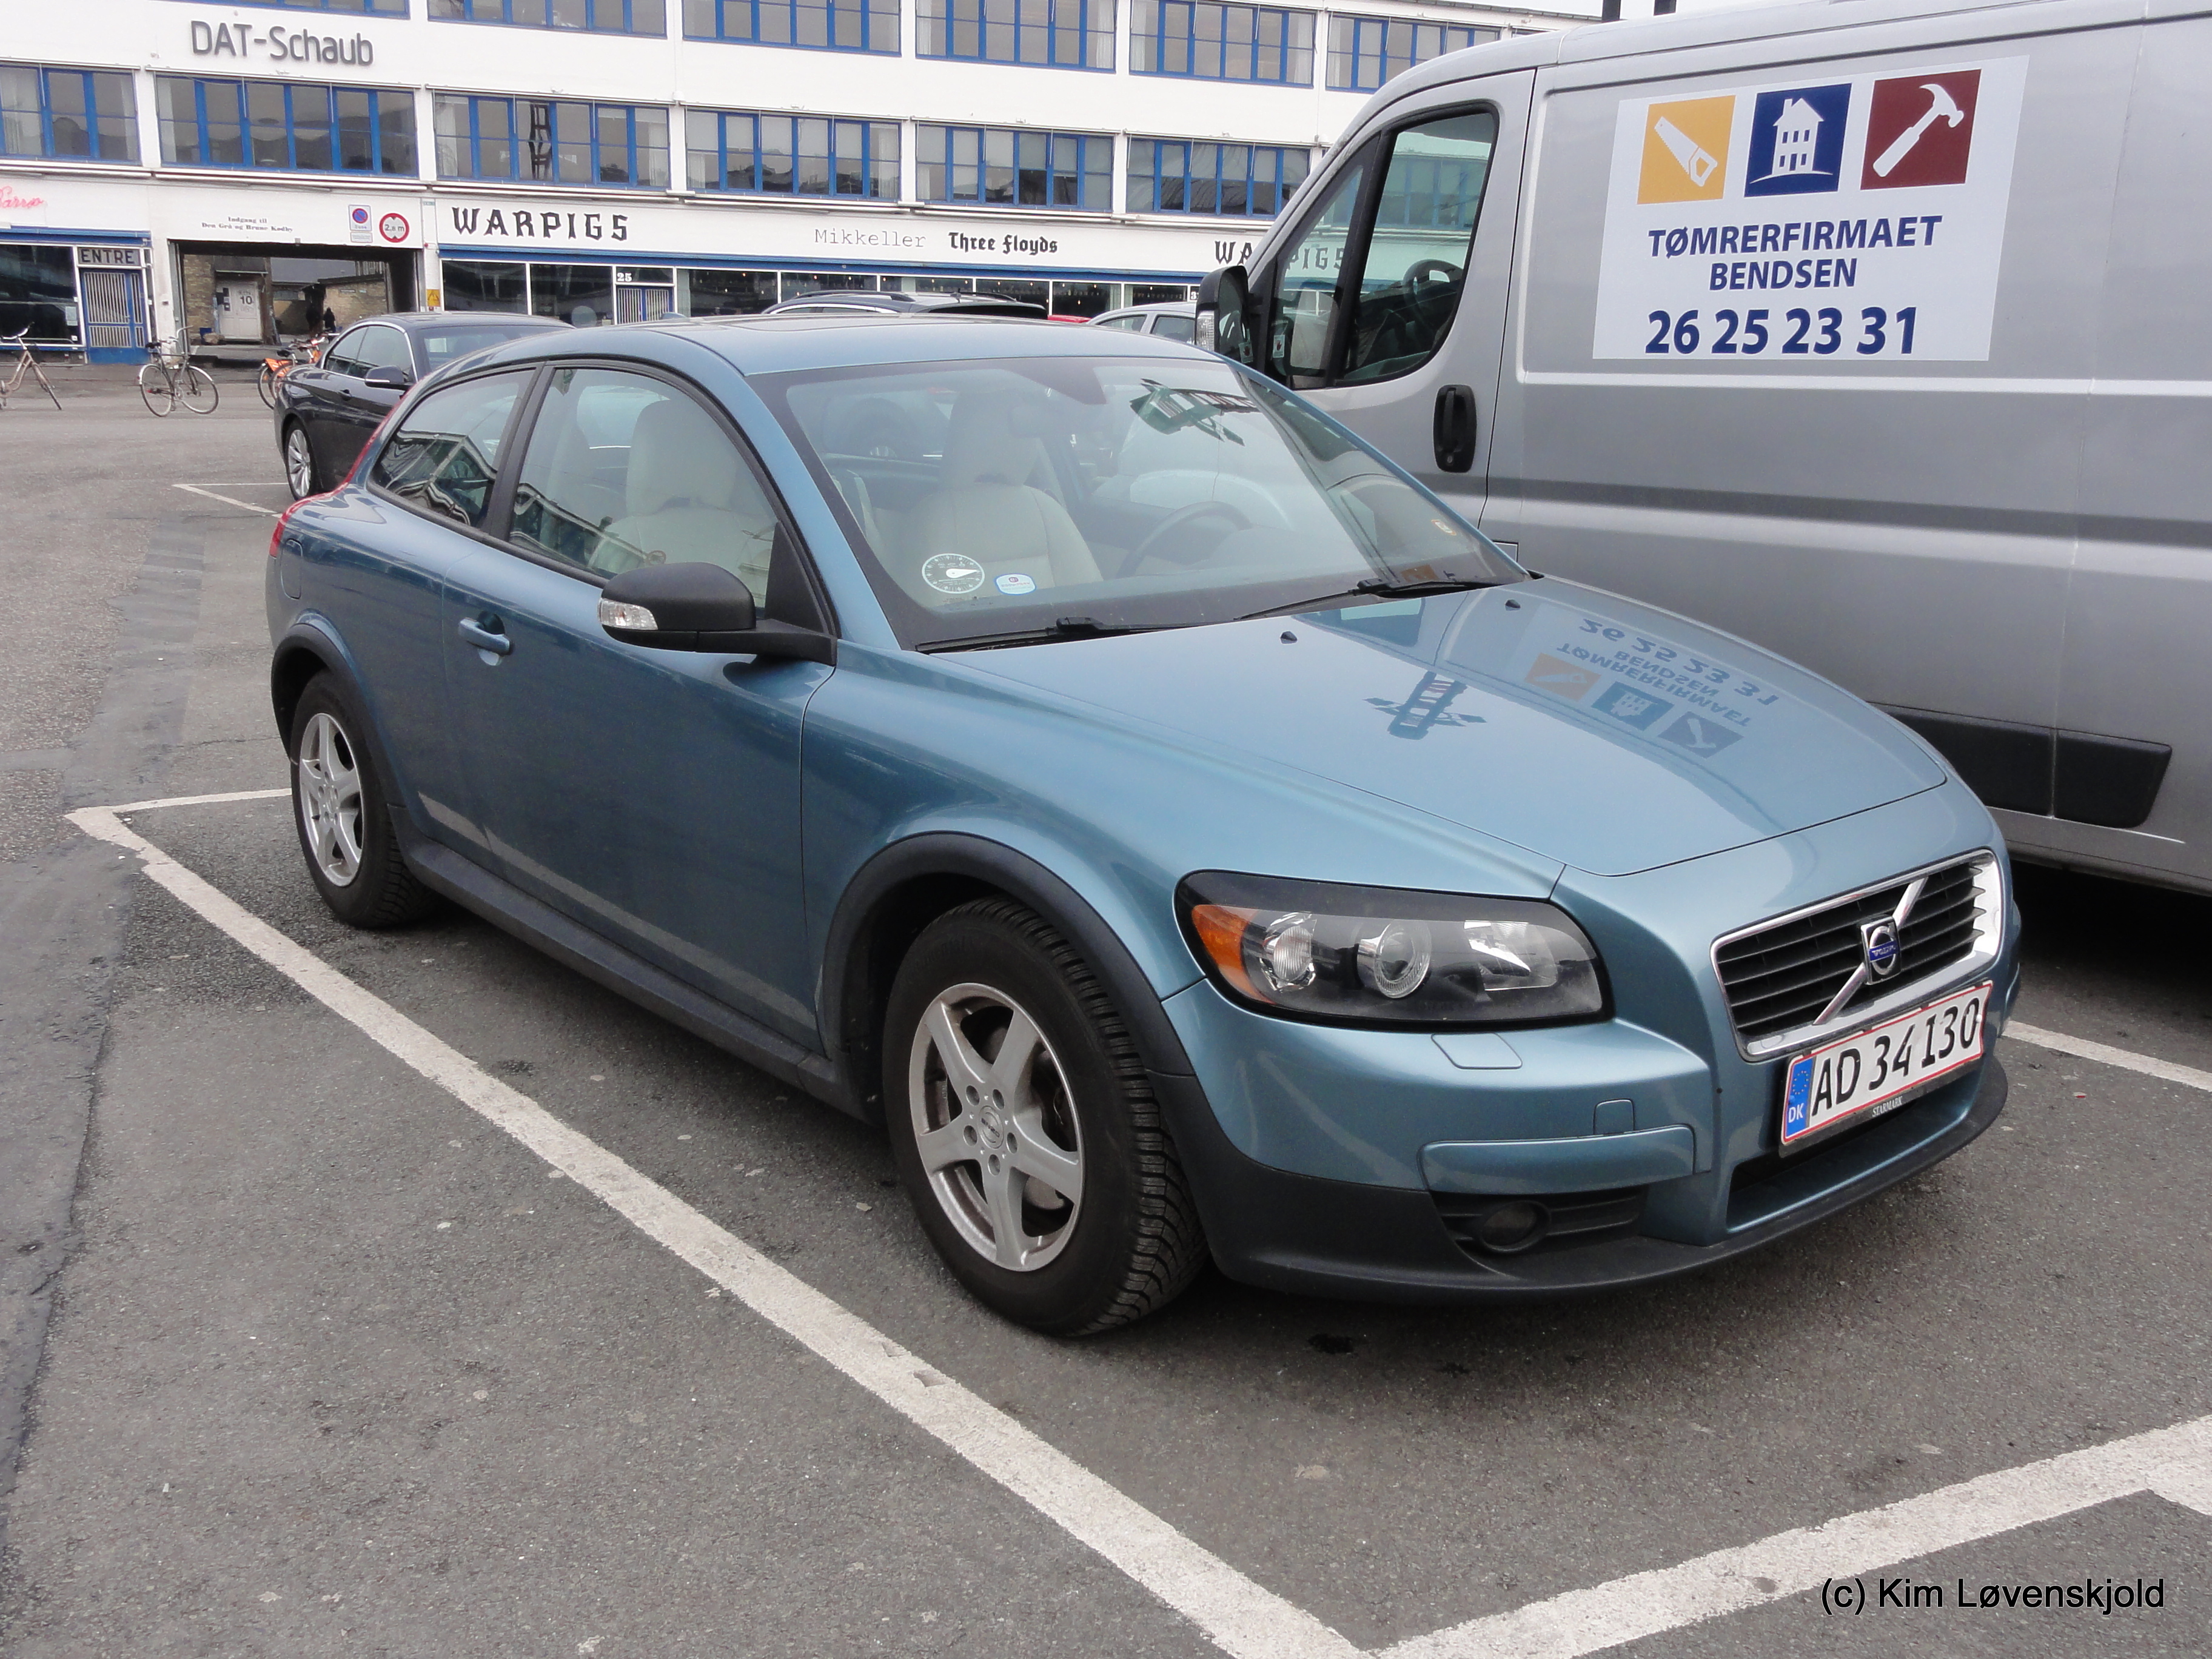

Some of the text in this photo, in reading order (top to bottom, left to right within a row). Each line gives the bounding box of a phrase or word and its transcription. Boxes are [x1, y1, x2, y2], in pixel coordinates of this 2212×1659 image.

[190, 20, 374, 65] DAT-Schaub
[452, 207, 628, 241] WARPIGS
[814, 228, 926, 247] Mikkeller
[948, 232, 996, 253] Three
[1648, 215, 1943, 259] TØMRERFIRMAET
[81, 249, 135, 264] ENTRE
[1215, 241, 1346, 270] WAPIGS
[617, 272, 632, 282] 25
[1709, 258, 1858, 290] BENDSEN
[240, 295, 252, 305] 10
[1644, 306, 1917, 355] 26 25 23 31
[1811, 997, 1979, 1116] AD 34 130
[1788, 1103, 1805, 1124] DK
[1872, 1096, 1903, 1117] STARMARK
